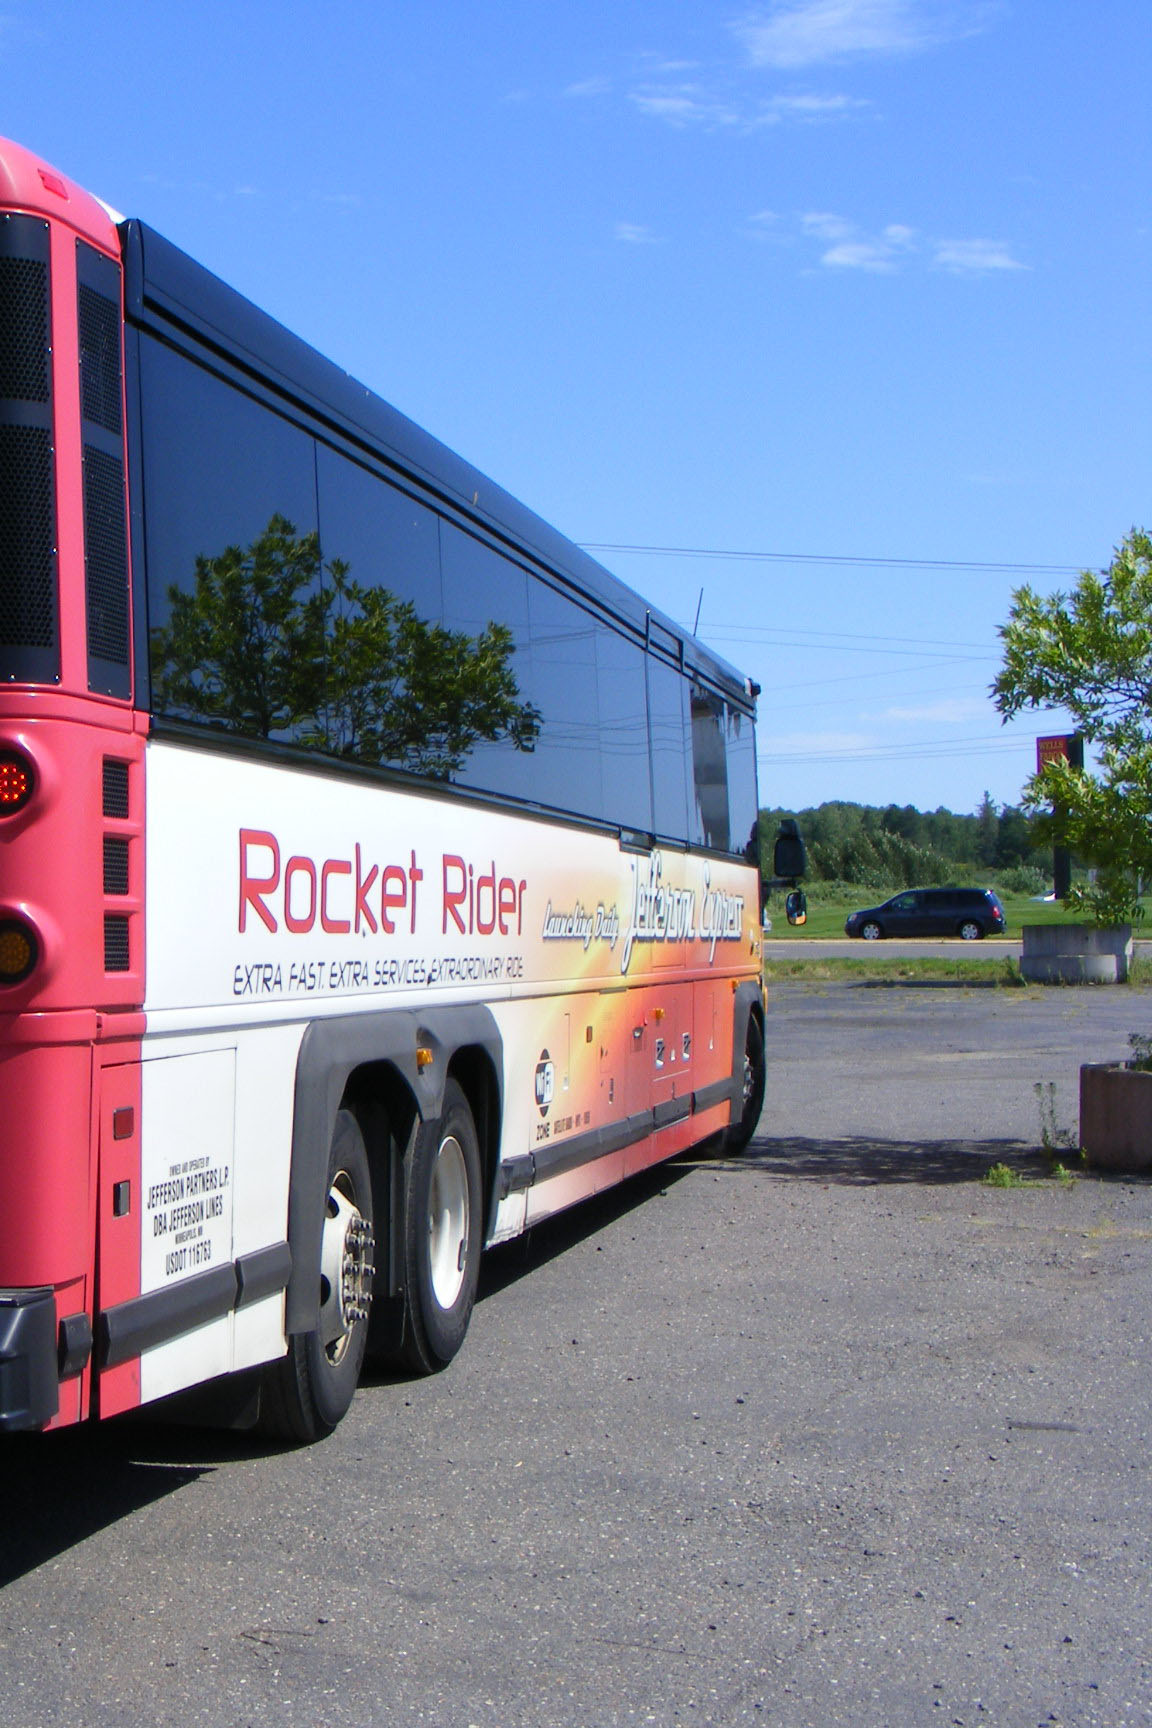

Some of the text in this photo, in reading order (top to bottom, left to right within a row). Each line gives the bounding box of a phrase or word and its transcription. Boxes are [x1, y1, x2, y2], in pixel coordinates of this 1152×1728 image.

[238, 828, 527, 936] Rocket Rider
[621, 850, 696, 975] Jefferson
[699, 860, 744, 965] Express
[233, 963, 283, 995] EXTRA
[329, 961, 369, 989] EXTRA
[431, 957, 505, 982] EXTRAORDINARY
[147, 1178, 185, 1210] JEFFERSON
[186, 1168, 218, 1198] PARTNERS
[153, 1195, 223, 1237] DBA JEFFERSON LINES
[166, 1248, 187, 1276] USDOT
